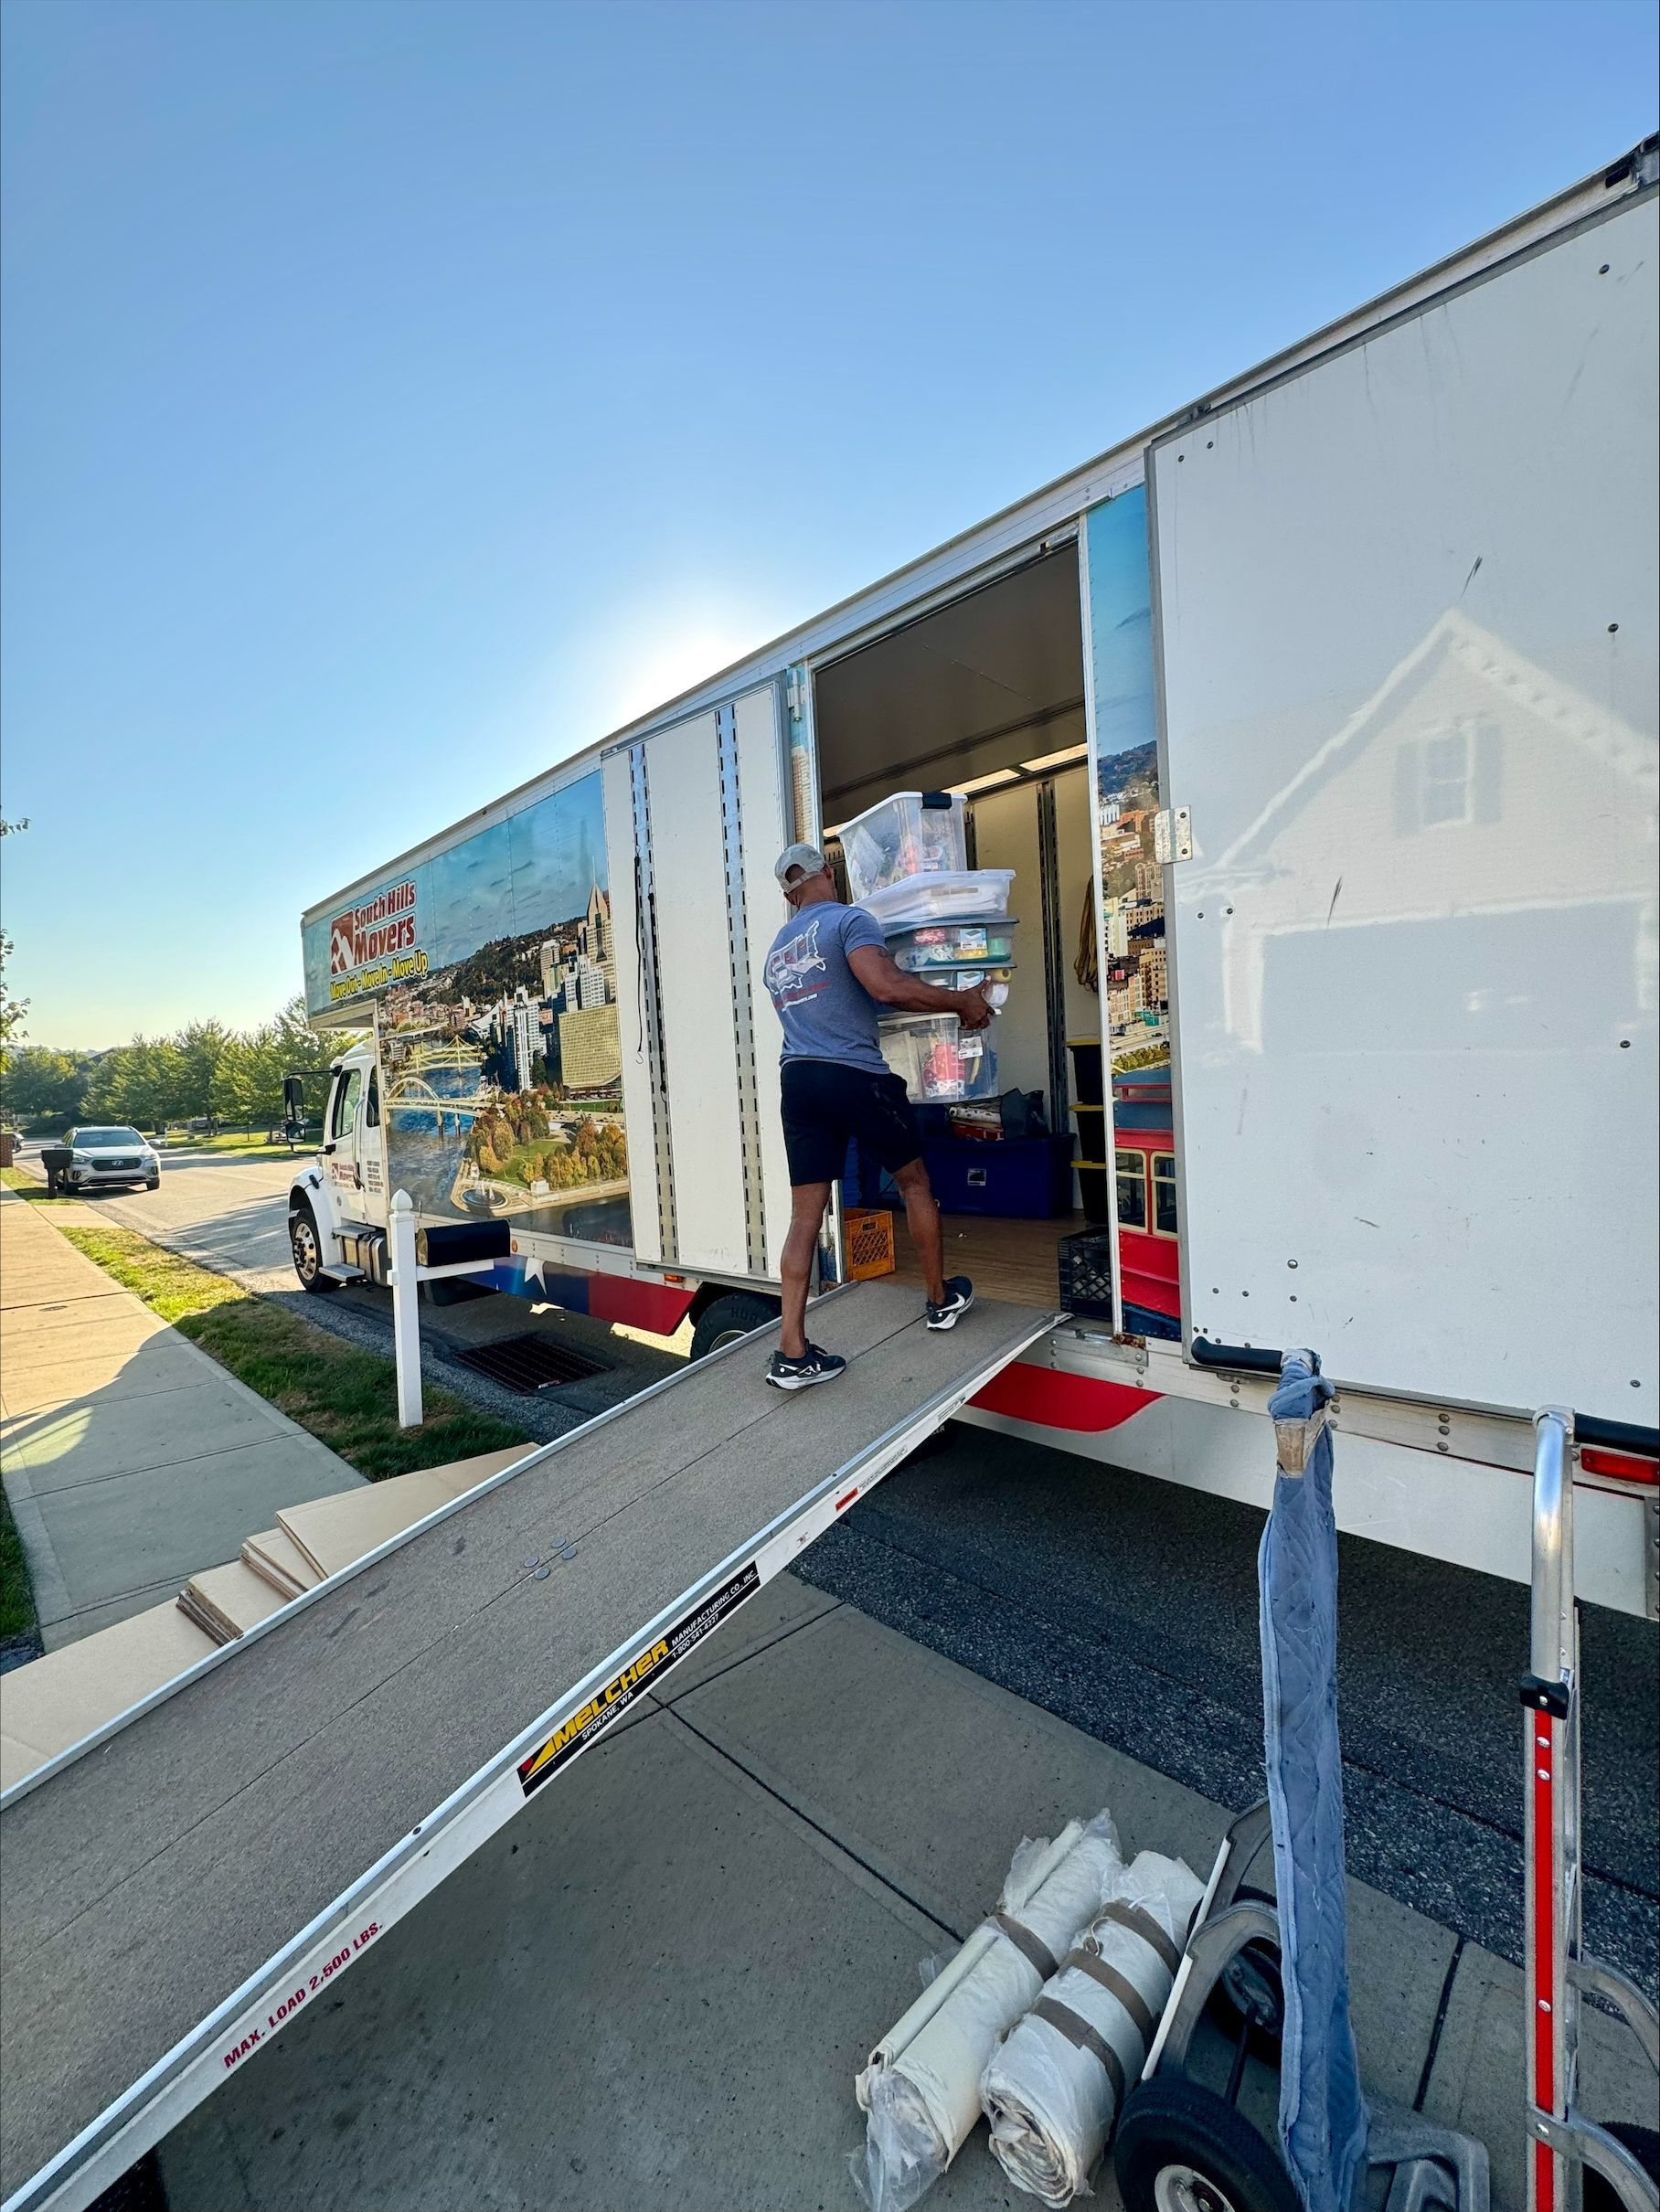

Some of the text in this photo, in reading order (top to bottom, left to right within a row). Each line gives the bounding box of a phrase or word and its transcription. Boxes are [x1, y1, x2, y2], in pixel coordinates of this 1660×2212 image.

[355, 882, 416, 931] South Hills
[355, 915, 416, 966] Movers
[331, 980, 346, 1001] Move
[362, 968, 380, 991] Move
[393, 955, 415, 981] Move
[415, 949, 429, 977] Up
[671, 1591, 730, 1647] MANUFACTURING
[671, 1613, 719, 1659] 1-800-541-4227
[620, 1691, 634, 1706] WA
[223, 1921, 384, 2069] MAX. LOAD 2,500 LBS.
